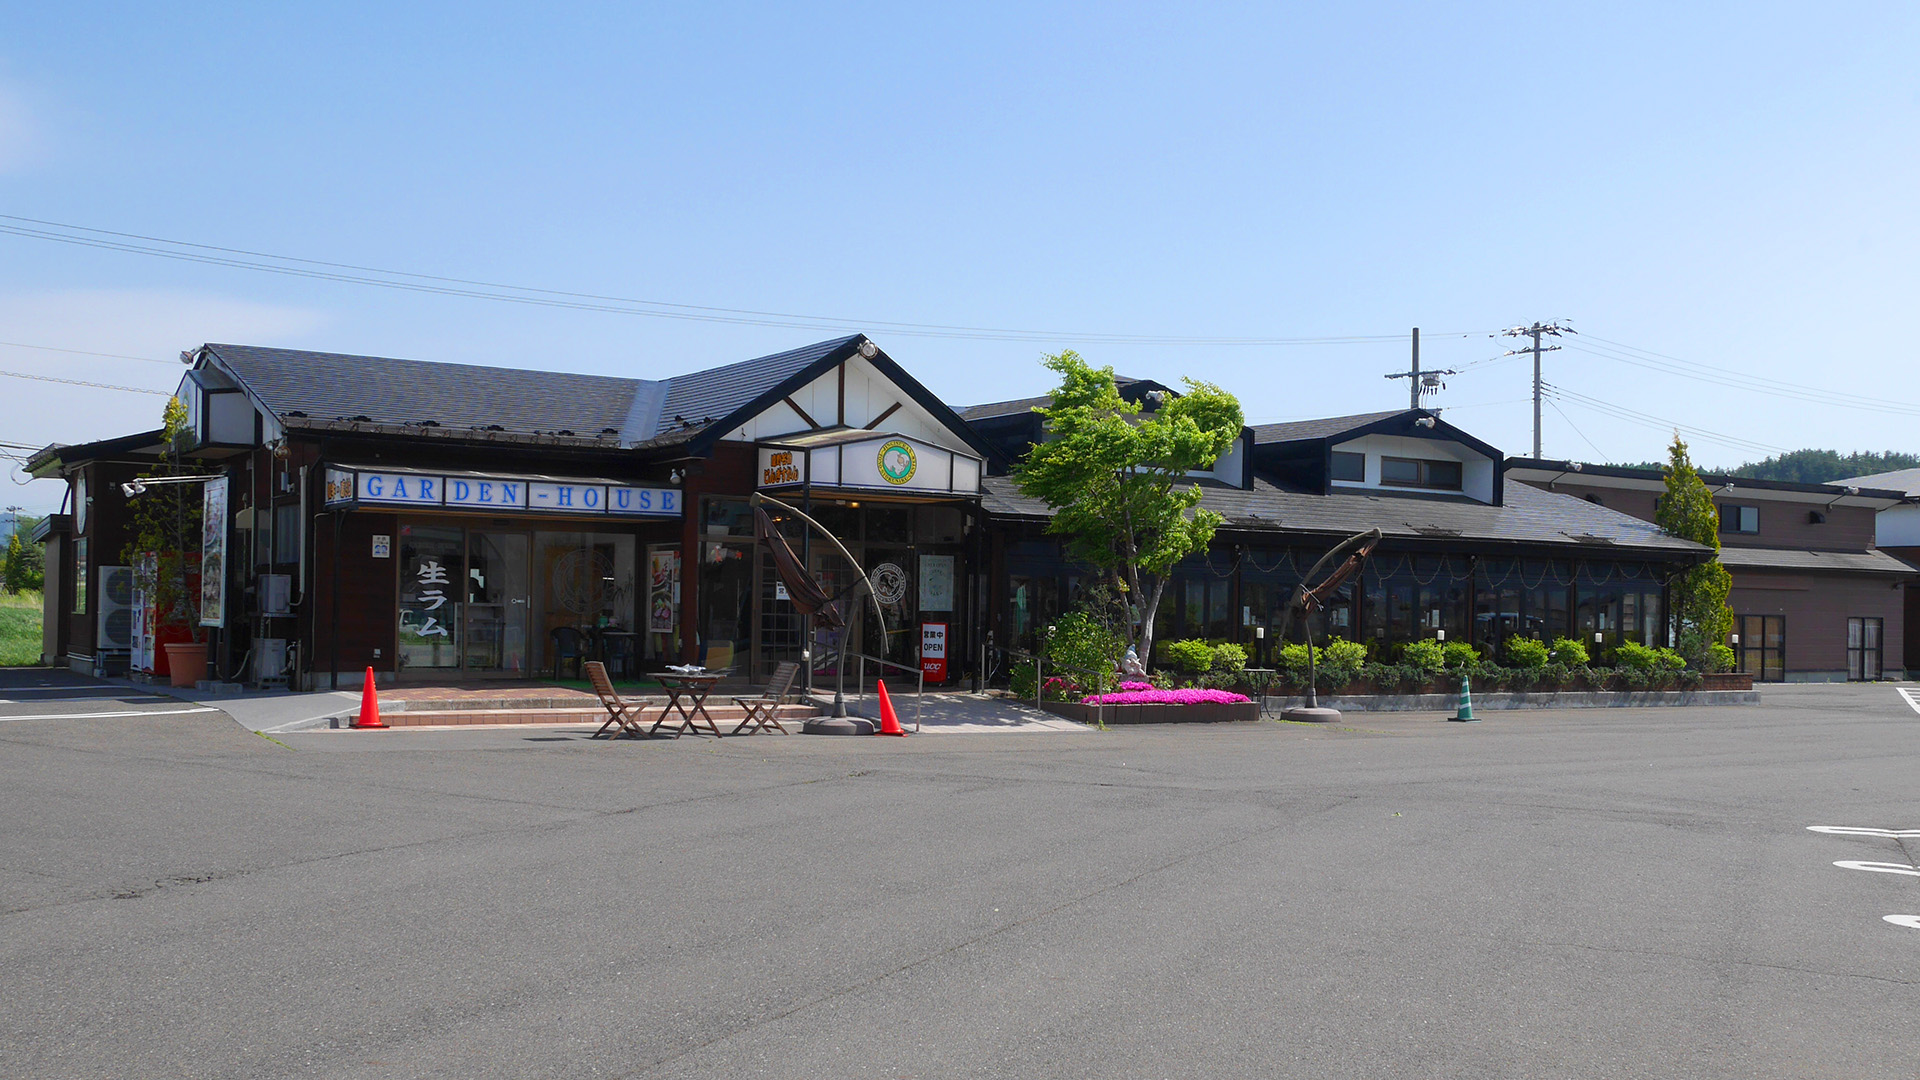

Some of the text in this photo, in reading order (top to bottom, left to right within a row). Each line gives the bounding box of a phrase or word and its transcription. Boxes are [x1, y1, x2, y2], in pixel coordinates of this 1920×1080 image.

[416, 561, 450, 637] 生ラム
[924, 631, 943, 639] 営業中
[924, 643, 943, 651] OPEN
